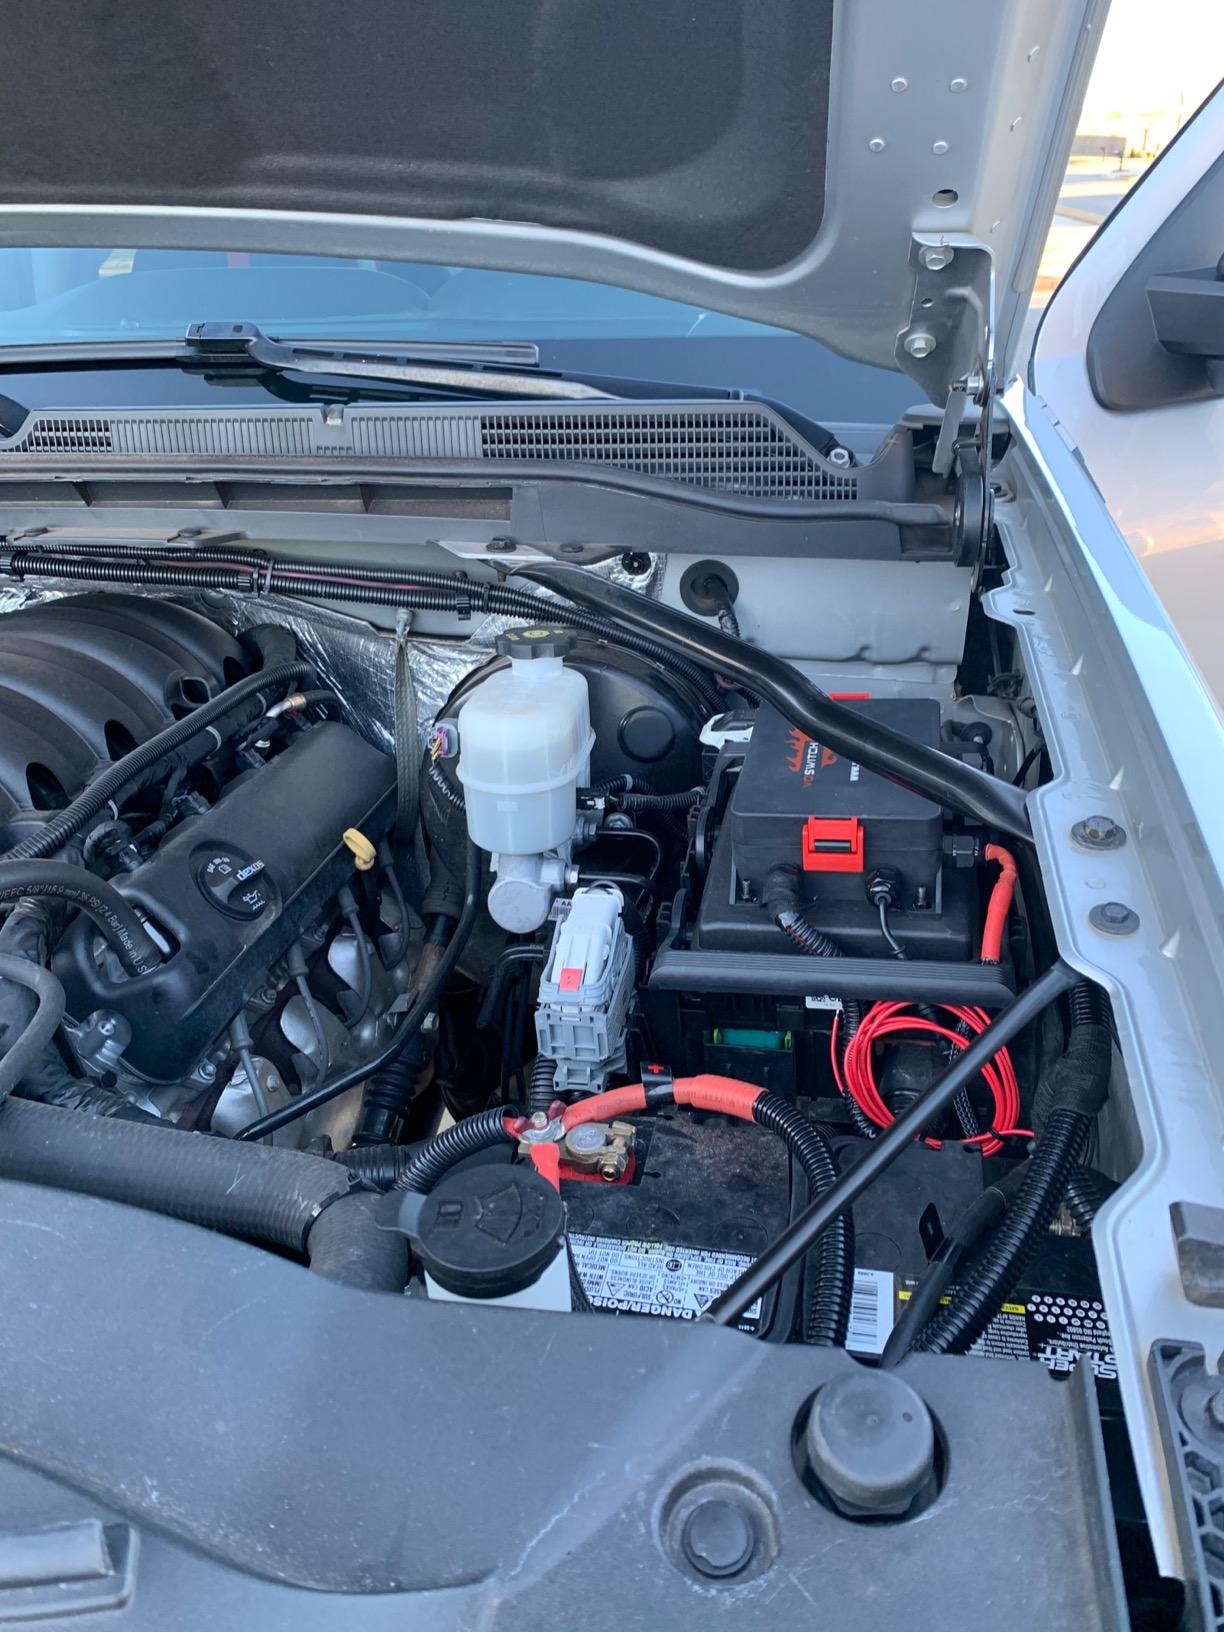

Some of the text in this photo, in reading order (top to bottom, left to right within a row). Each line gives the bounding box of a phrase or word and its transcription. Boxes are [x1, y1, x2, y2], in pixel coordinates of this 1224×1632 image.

[236, 860, 266, 881] dexos
[116, 928, 133, 950] Made
[128, 949, 137, 959] in
[623, 1290, 651, 1300] SULFURIC
[1079, 1343, 1109, 1353] Automotive
